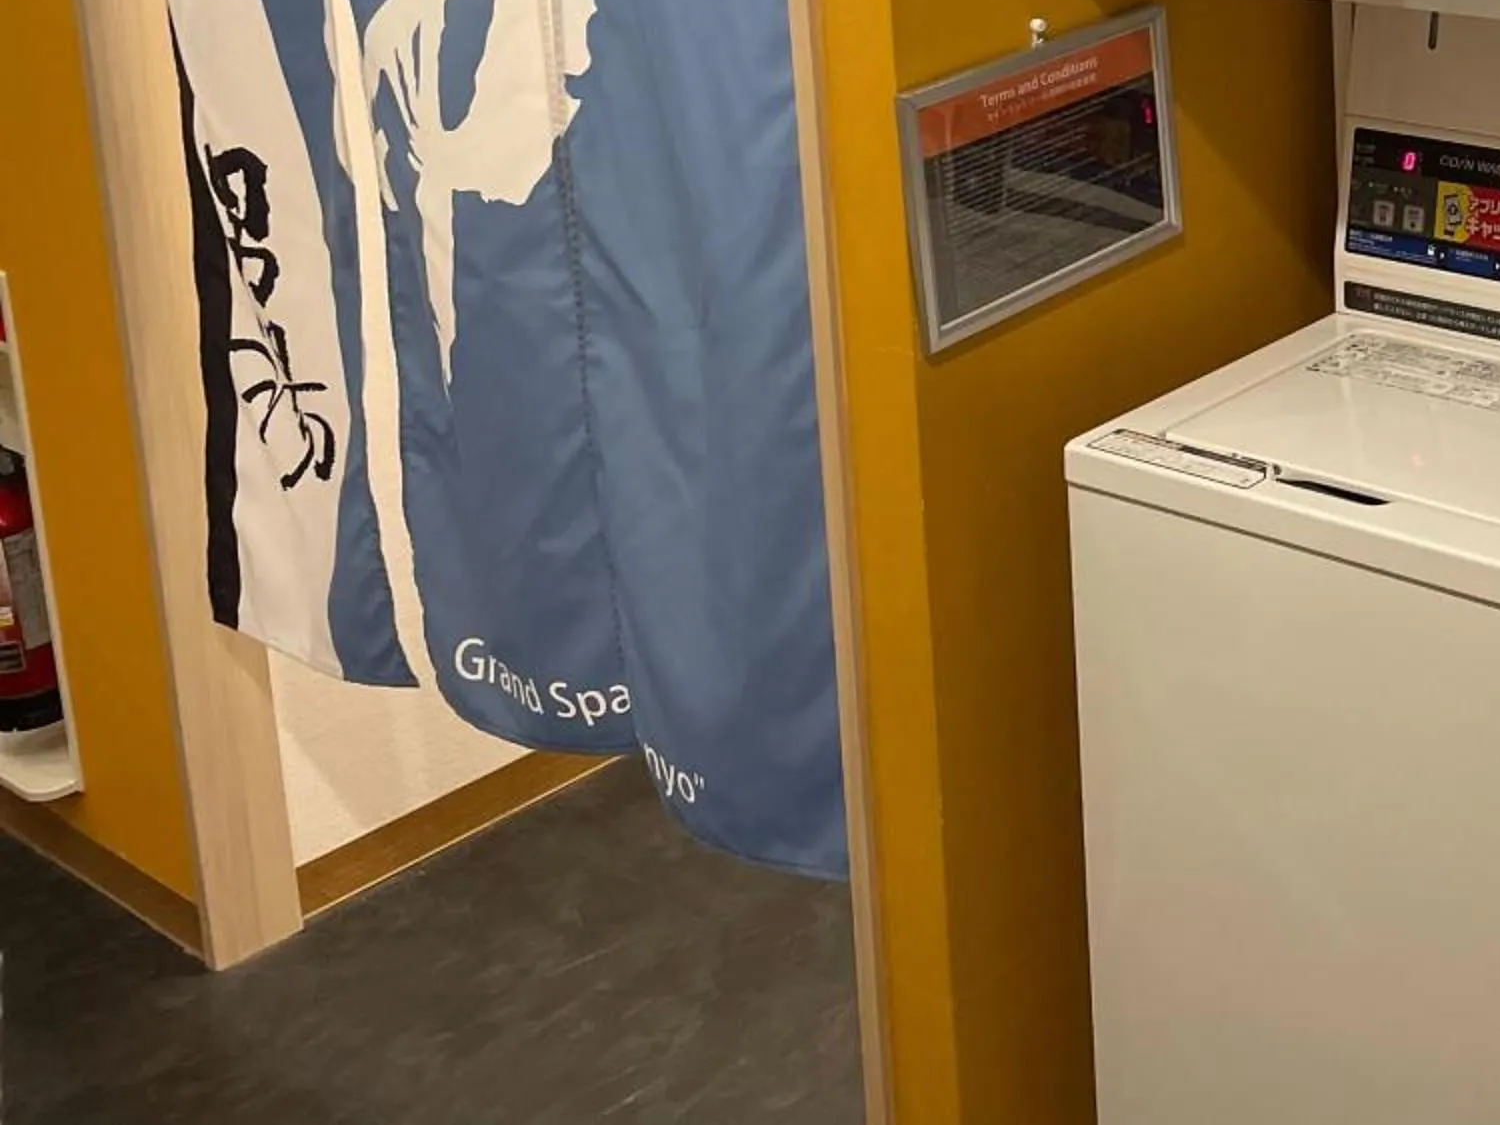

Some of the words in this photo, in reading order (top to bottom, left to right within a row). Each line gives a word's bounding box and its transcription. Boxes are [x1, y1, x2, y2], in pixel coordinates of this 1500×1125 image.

[980, 87, 1015, 108] Terms
[1402, 151, 1417, 172] 0
[454, 637, 545, 715] Grand
[549, 681, 632, 727] Spa
